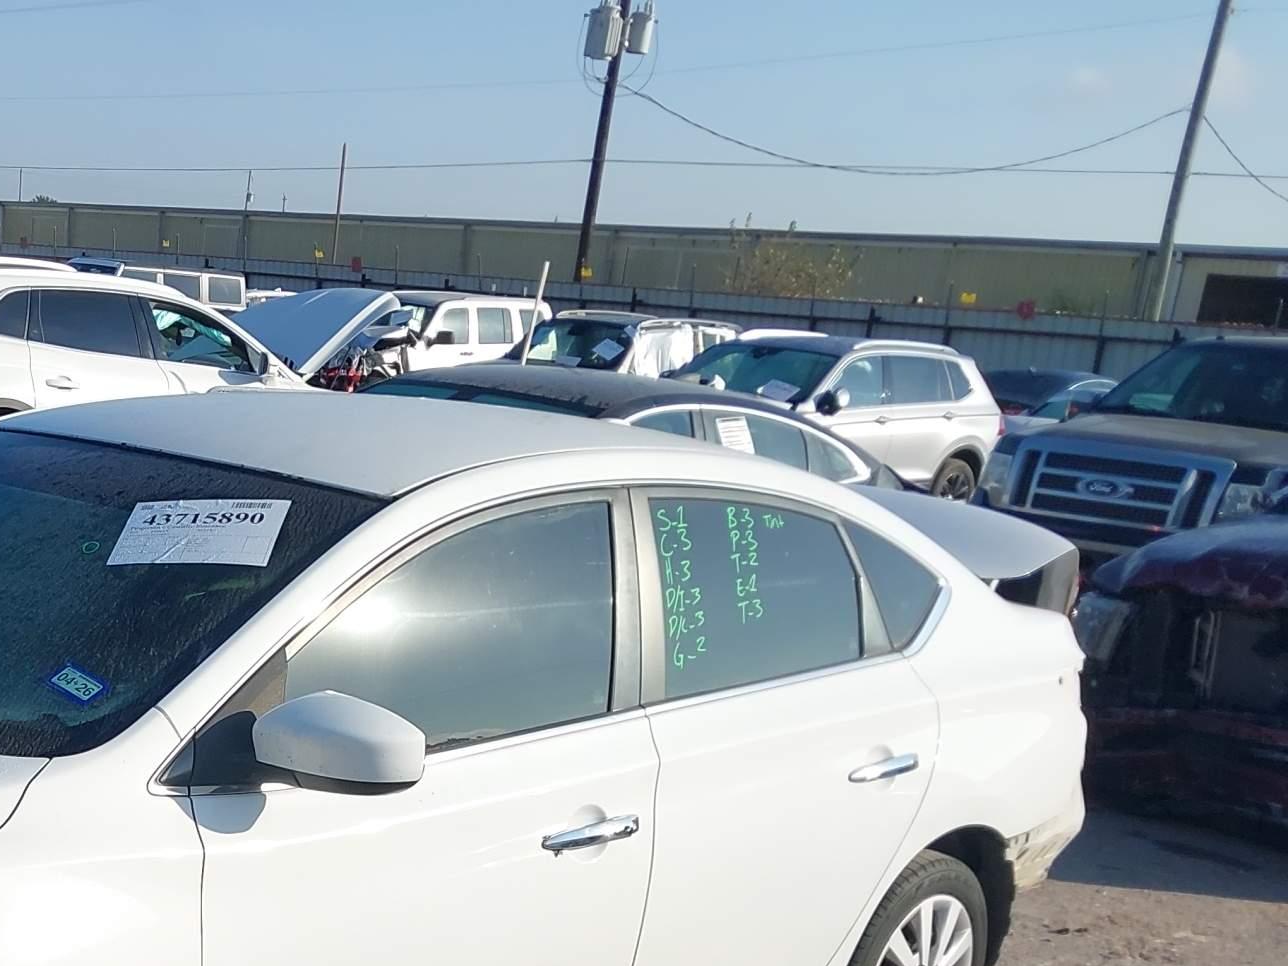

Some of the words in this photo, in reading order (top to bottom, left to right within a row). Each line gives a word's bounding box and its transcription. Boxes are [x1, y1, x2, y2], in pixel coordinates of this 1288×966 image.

[142, 512, 265, 526] 43715890
[727, 506, 754, 529] B-3
[729, 530, 759, 553] P-3
[730, 552, 759, 573] T-2
[737, 599, 764, 625] T-3
